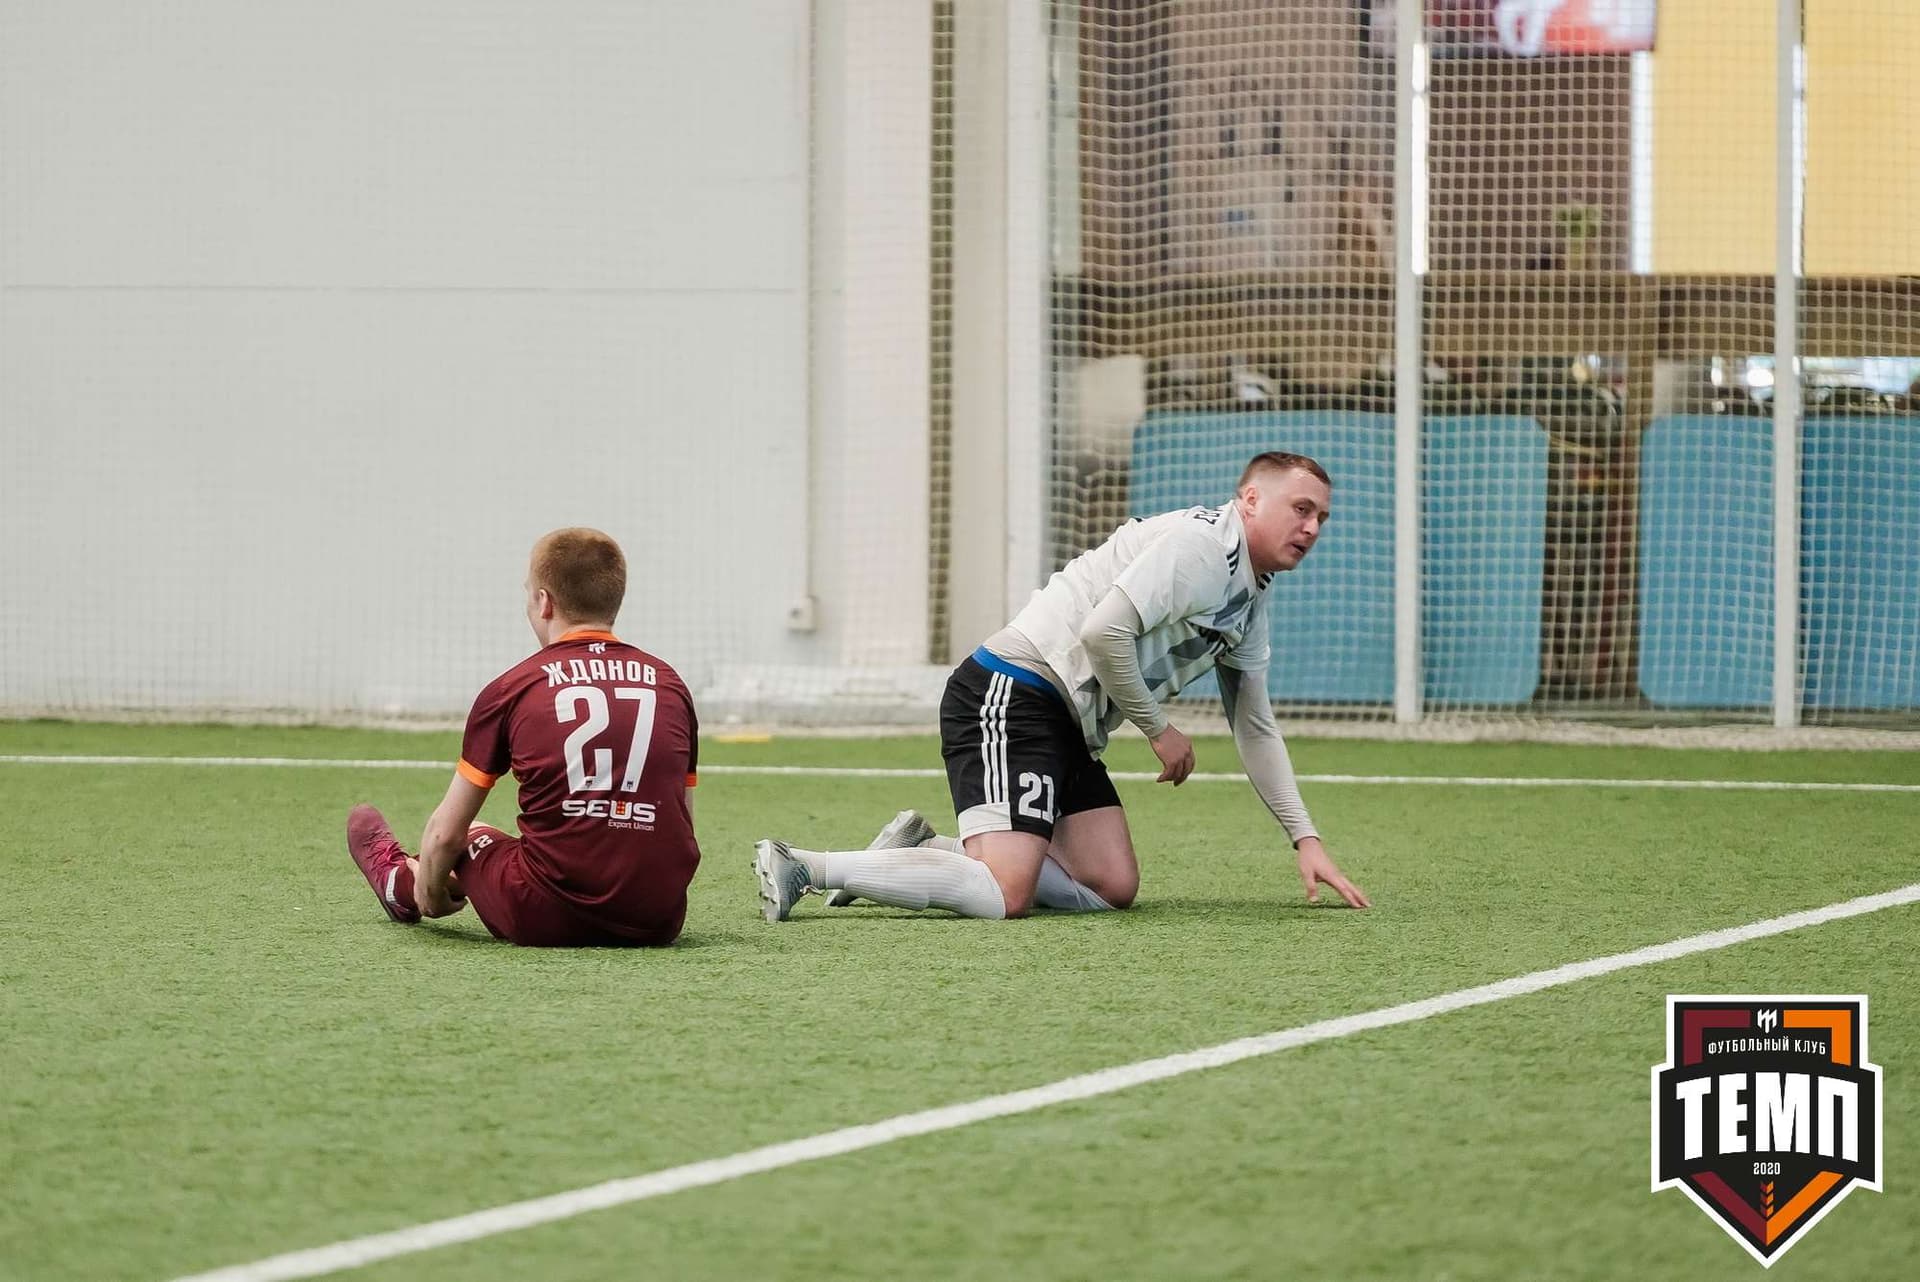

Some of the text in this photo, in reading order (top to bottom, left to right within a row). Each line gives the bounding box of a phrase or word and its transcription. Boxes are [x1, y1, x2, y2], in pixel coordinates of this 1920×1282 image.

[541, 659, 657, 687] ЖДАНОВ
[554, 685, 657, 794] 27
[561, 799, 657, 823] SEUS
[1018, 771, 1055, 824] 21
[608, 819, 655, 832] Export Union
[468, 834, 494, 861] 27
